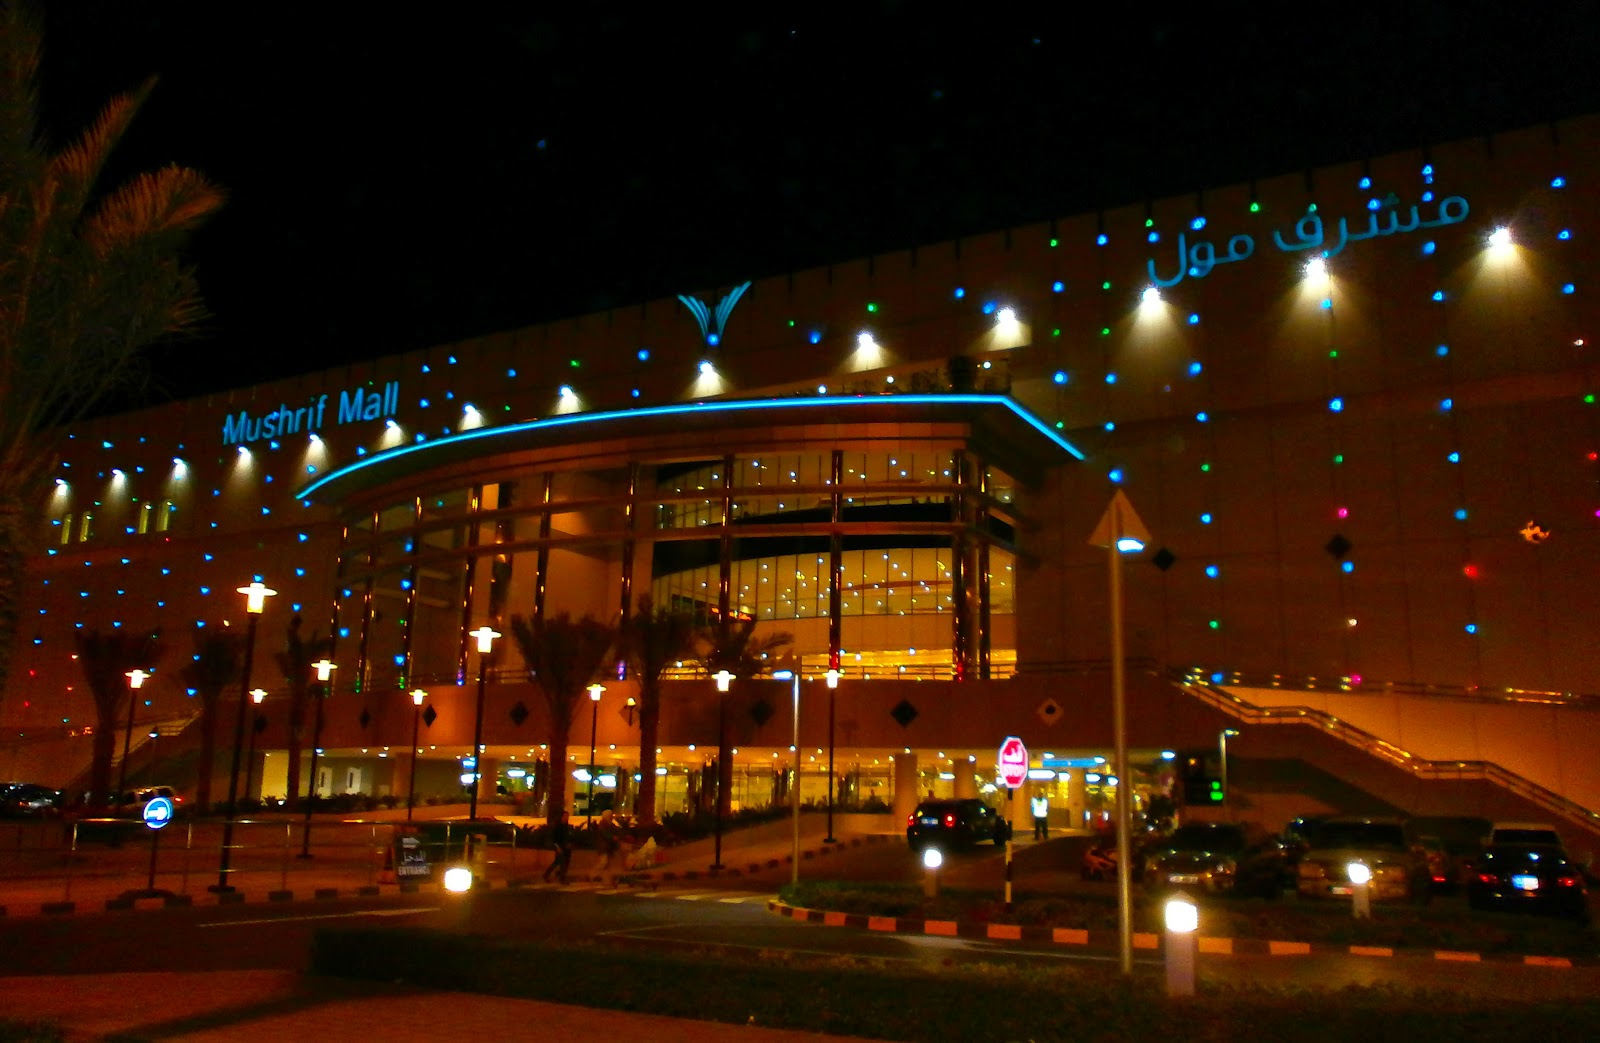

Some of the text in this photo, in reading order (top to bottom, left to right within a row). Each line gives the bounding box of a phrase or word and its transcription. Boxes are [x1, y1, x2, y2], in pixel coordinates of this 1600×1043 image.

[1147, 193, 1469, 287] مشرف مول
[222, 380, 399, 445] Mushrif Mall
[1002, 764, 1025, 776] STOP
